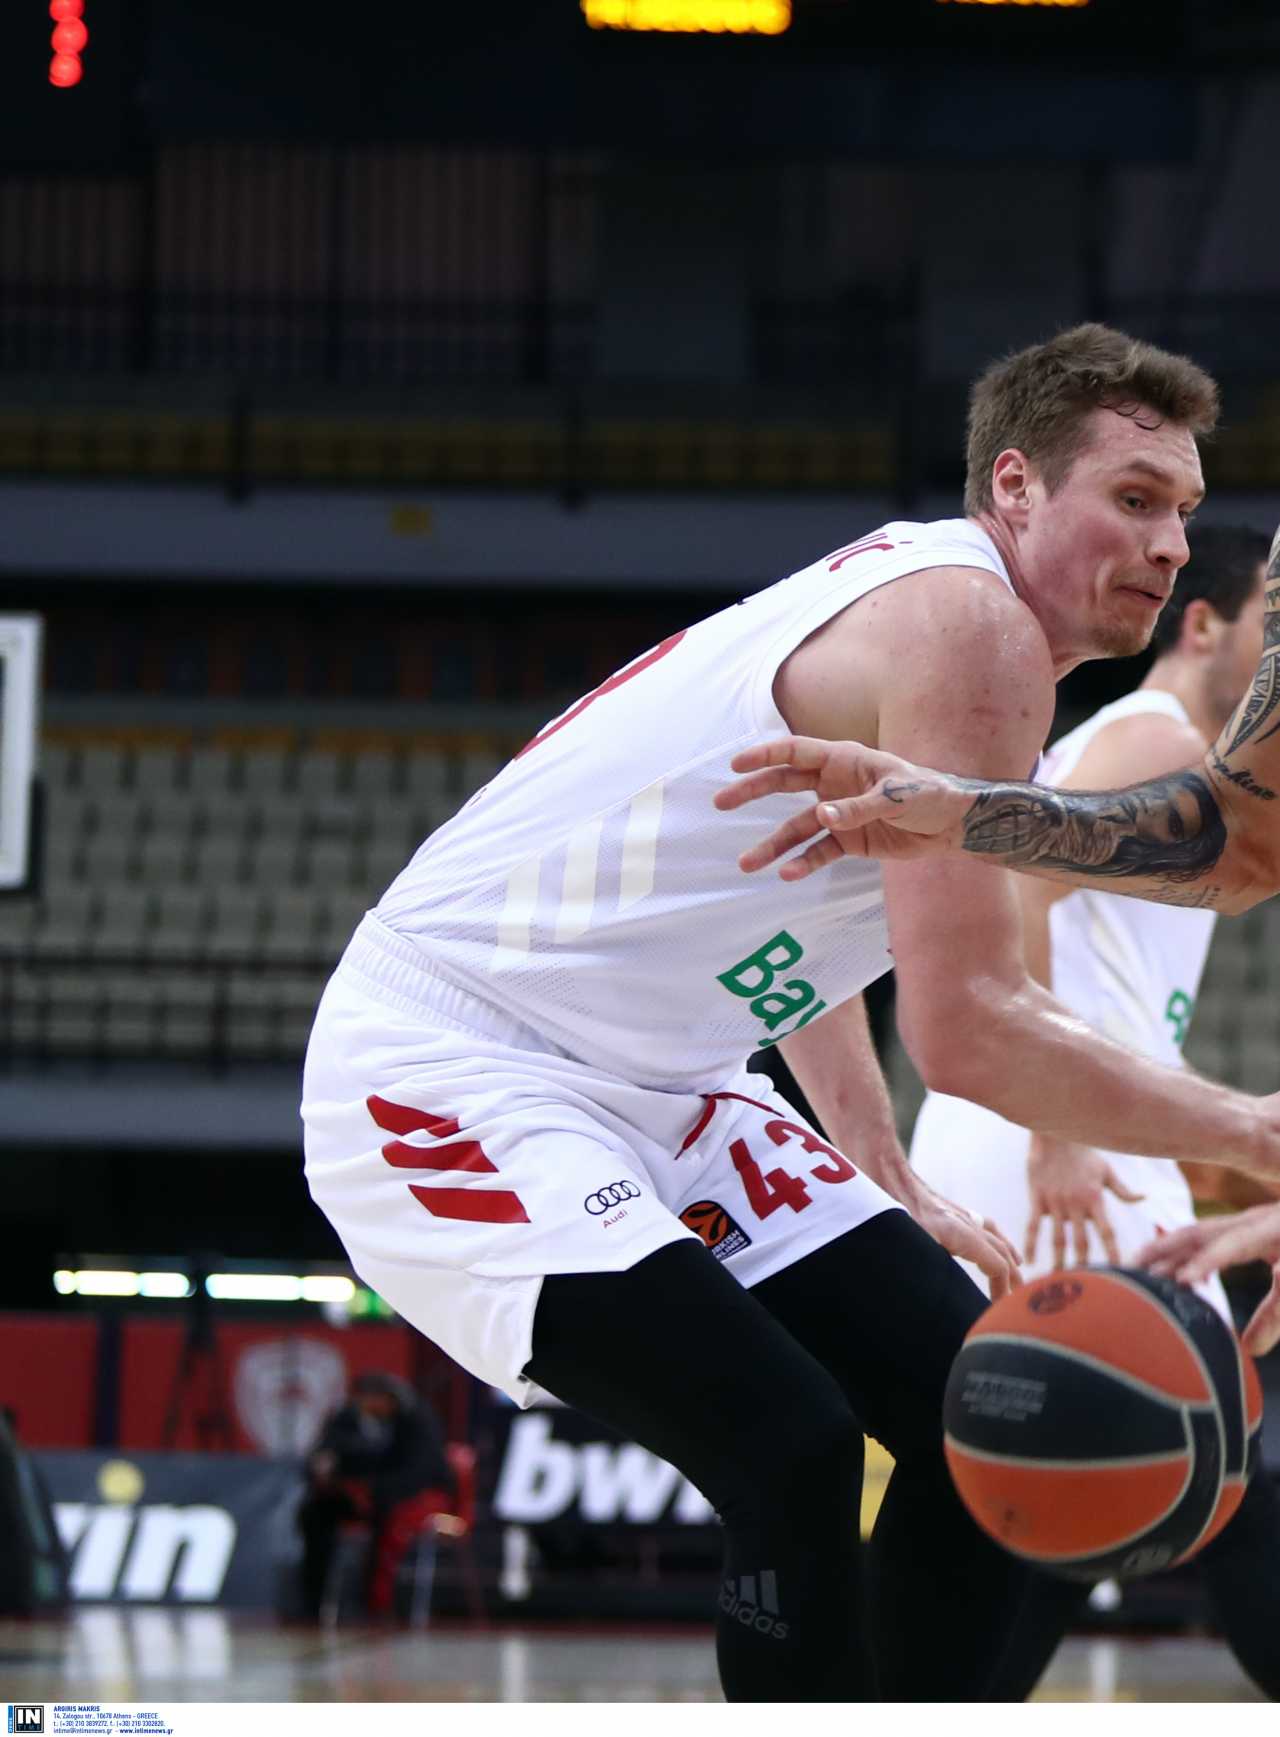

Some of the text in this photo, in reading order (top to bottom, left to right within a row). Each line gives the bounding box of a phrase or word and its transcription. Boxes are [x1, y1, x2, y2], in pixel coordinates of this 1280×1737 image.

[603, 1207, 629, 1229] Audi
[728, 1119, 858, 1221] 43
[52, 1458, 238, 1602] in
